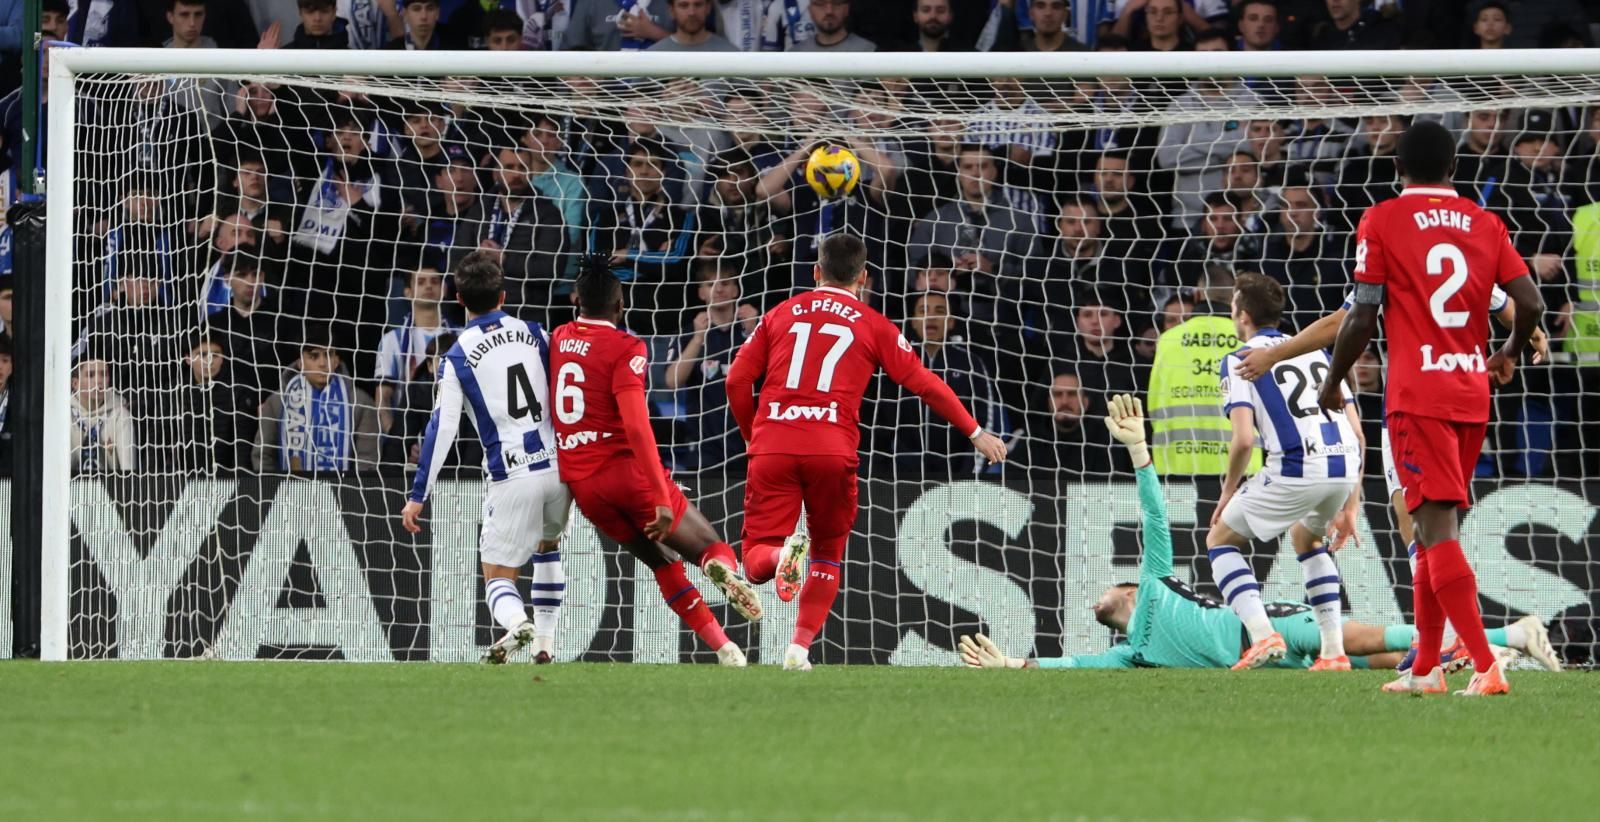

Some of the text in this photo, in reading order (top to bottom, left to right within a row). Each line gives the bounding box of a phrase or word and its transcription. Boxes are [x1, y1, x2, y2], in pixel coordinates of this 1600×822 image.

[1413, 208, 1473, 233] DJENE
[1426, 243, 1471, 328] 2
[791, 298, 862, 323] C. PÉREZ
[464, 330, 541, 369] ZUBIMENDI
[559, 339, 591, 357] UCHE
[1181, 332, 1238, 348] SABICO
[786, 321, 855, 393] 17
[1420, 344, 1487, 373] Lowi
[507, 362, 543, 423] 4
[555, 362, 585, 424] 6
[767, 401, 838, 423] Lowi
